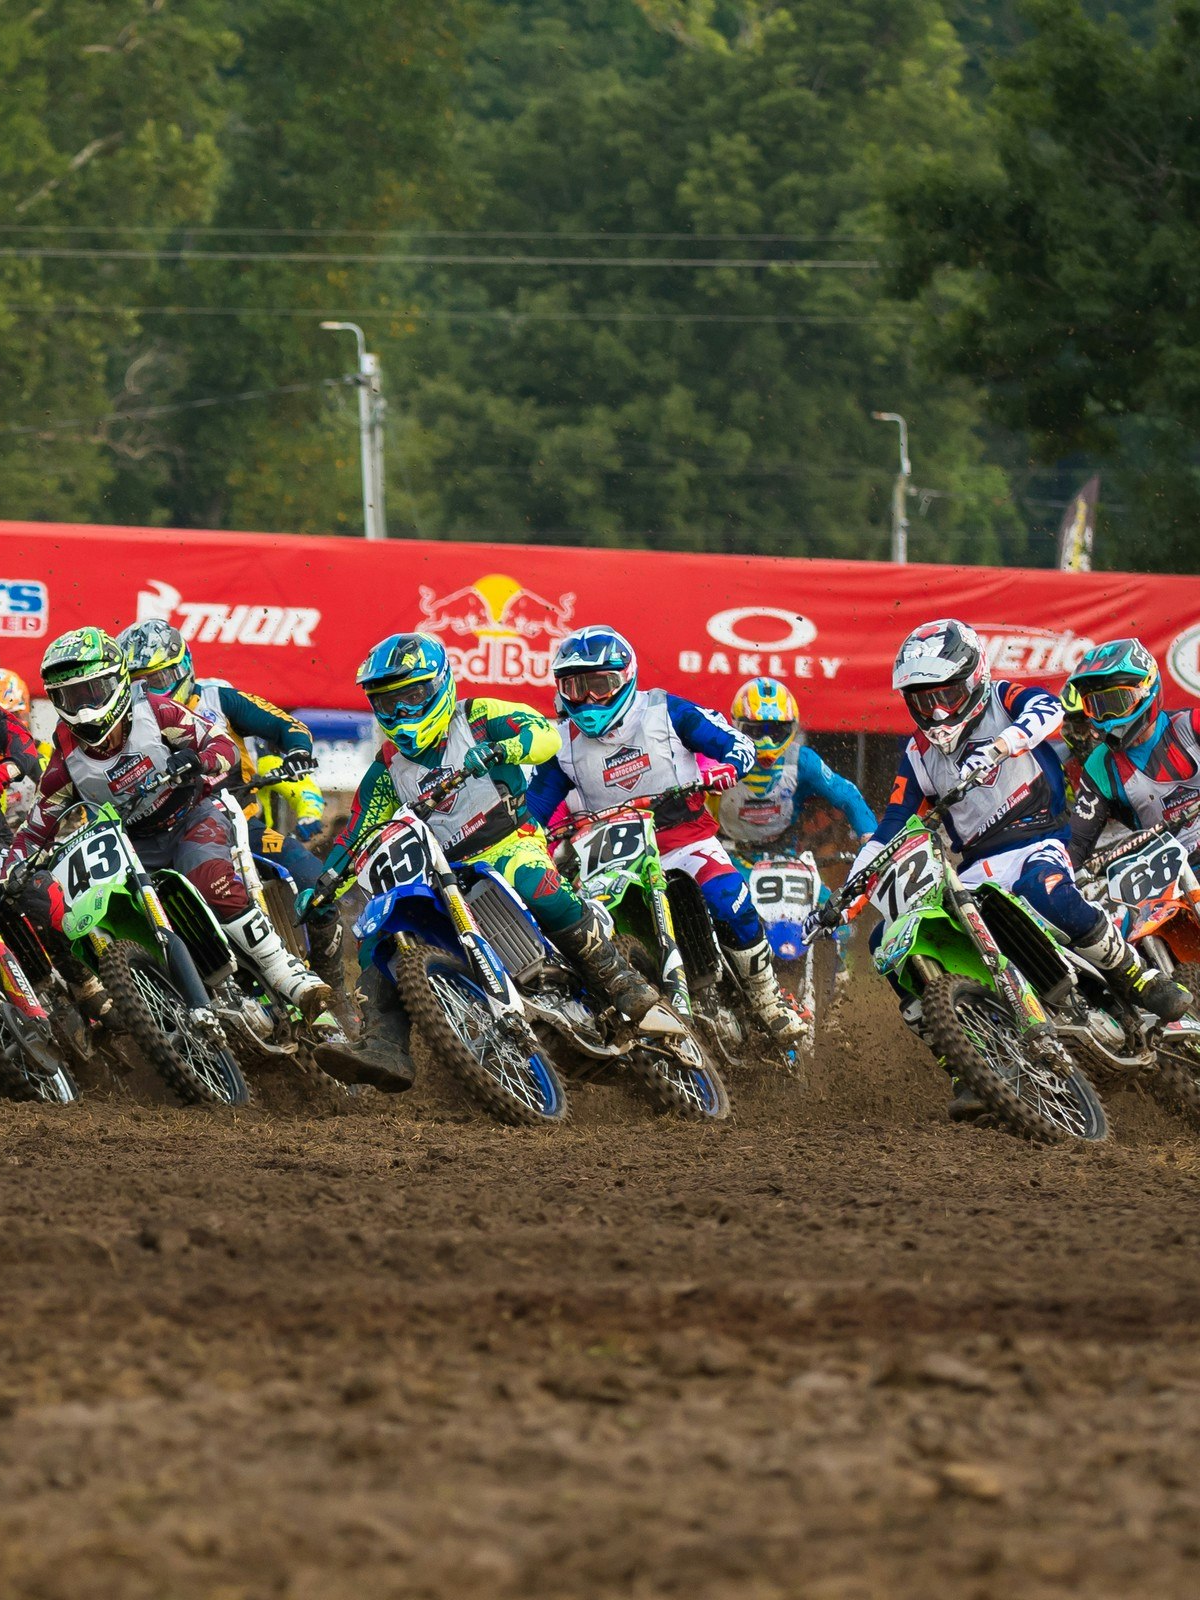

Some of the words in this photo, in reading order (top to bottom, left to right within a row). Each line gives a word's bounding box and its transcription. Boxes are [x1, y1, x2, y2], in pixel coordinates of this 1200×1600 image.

[177, 601, 321, 647] THOR
[678, 650, 844, 679] OAKLEY
[64, 835, 84, 856] LUCAS
[83, 828, 97, 843] OIL
[67, 832, 122, 899] 43
[368, 832, 425, 895] 65
[582, 822, 644, 878] 18
[756, 875, 815, 904] 93
[875, 849, 935, 922] 72
[1119, 846, 1182, 906] 68
[6, 960, 37, 1008] DUNLOP
[471, 946, 504, 994] MICHELIN
